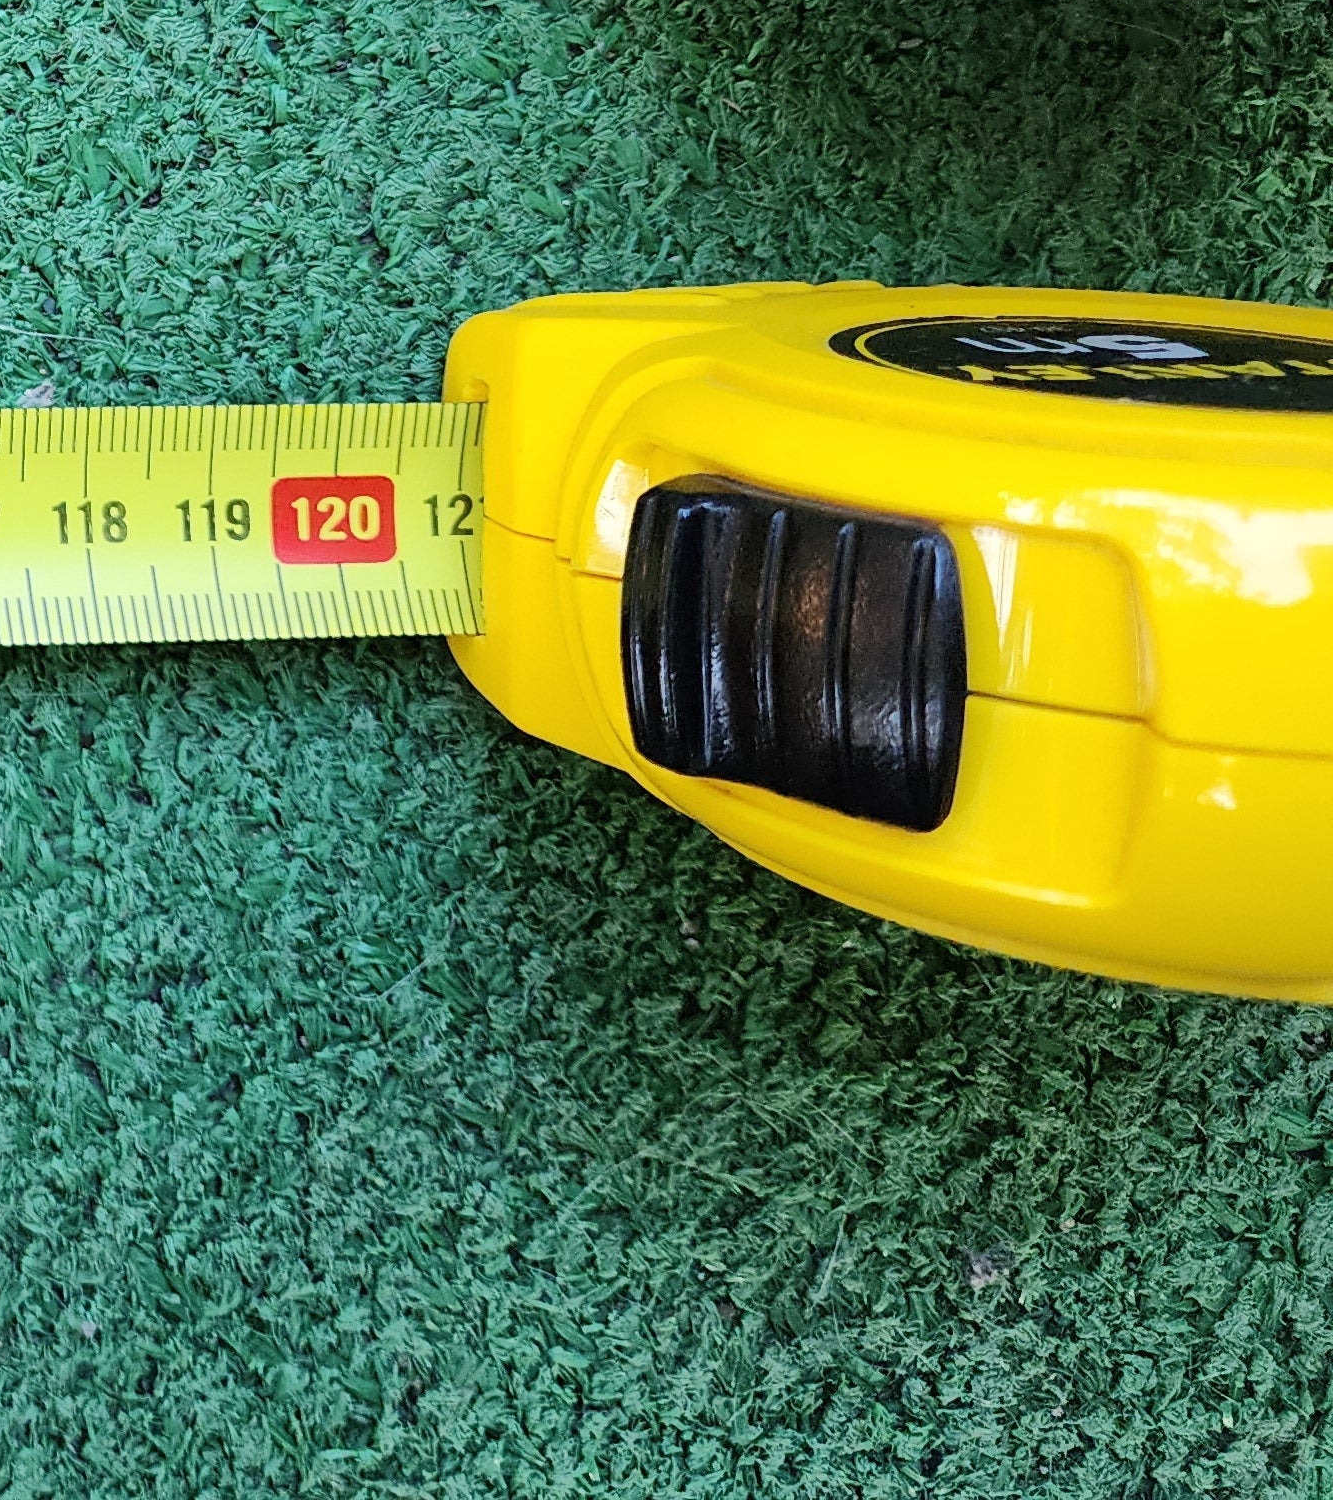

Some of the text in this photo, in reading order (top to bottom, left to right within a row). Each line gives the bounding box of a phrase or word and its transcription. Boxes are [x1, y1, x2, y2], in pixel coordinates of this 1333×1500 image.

[957, 358, 1333, 381] TANLEY
[51, 501, 128, 545] 118
[175, 499, 252, 543] 119
[291, 496, 380, 542] 120
[423, 493, 484, 536] 12
